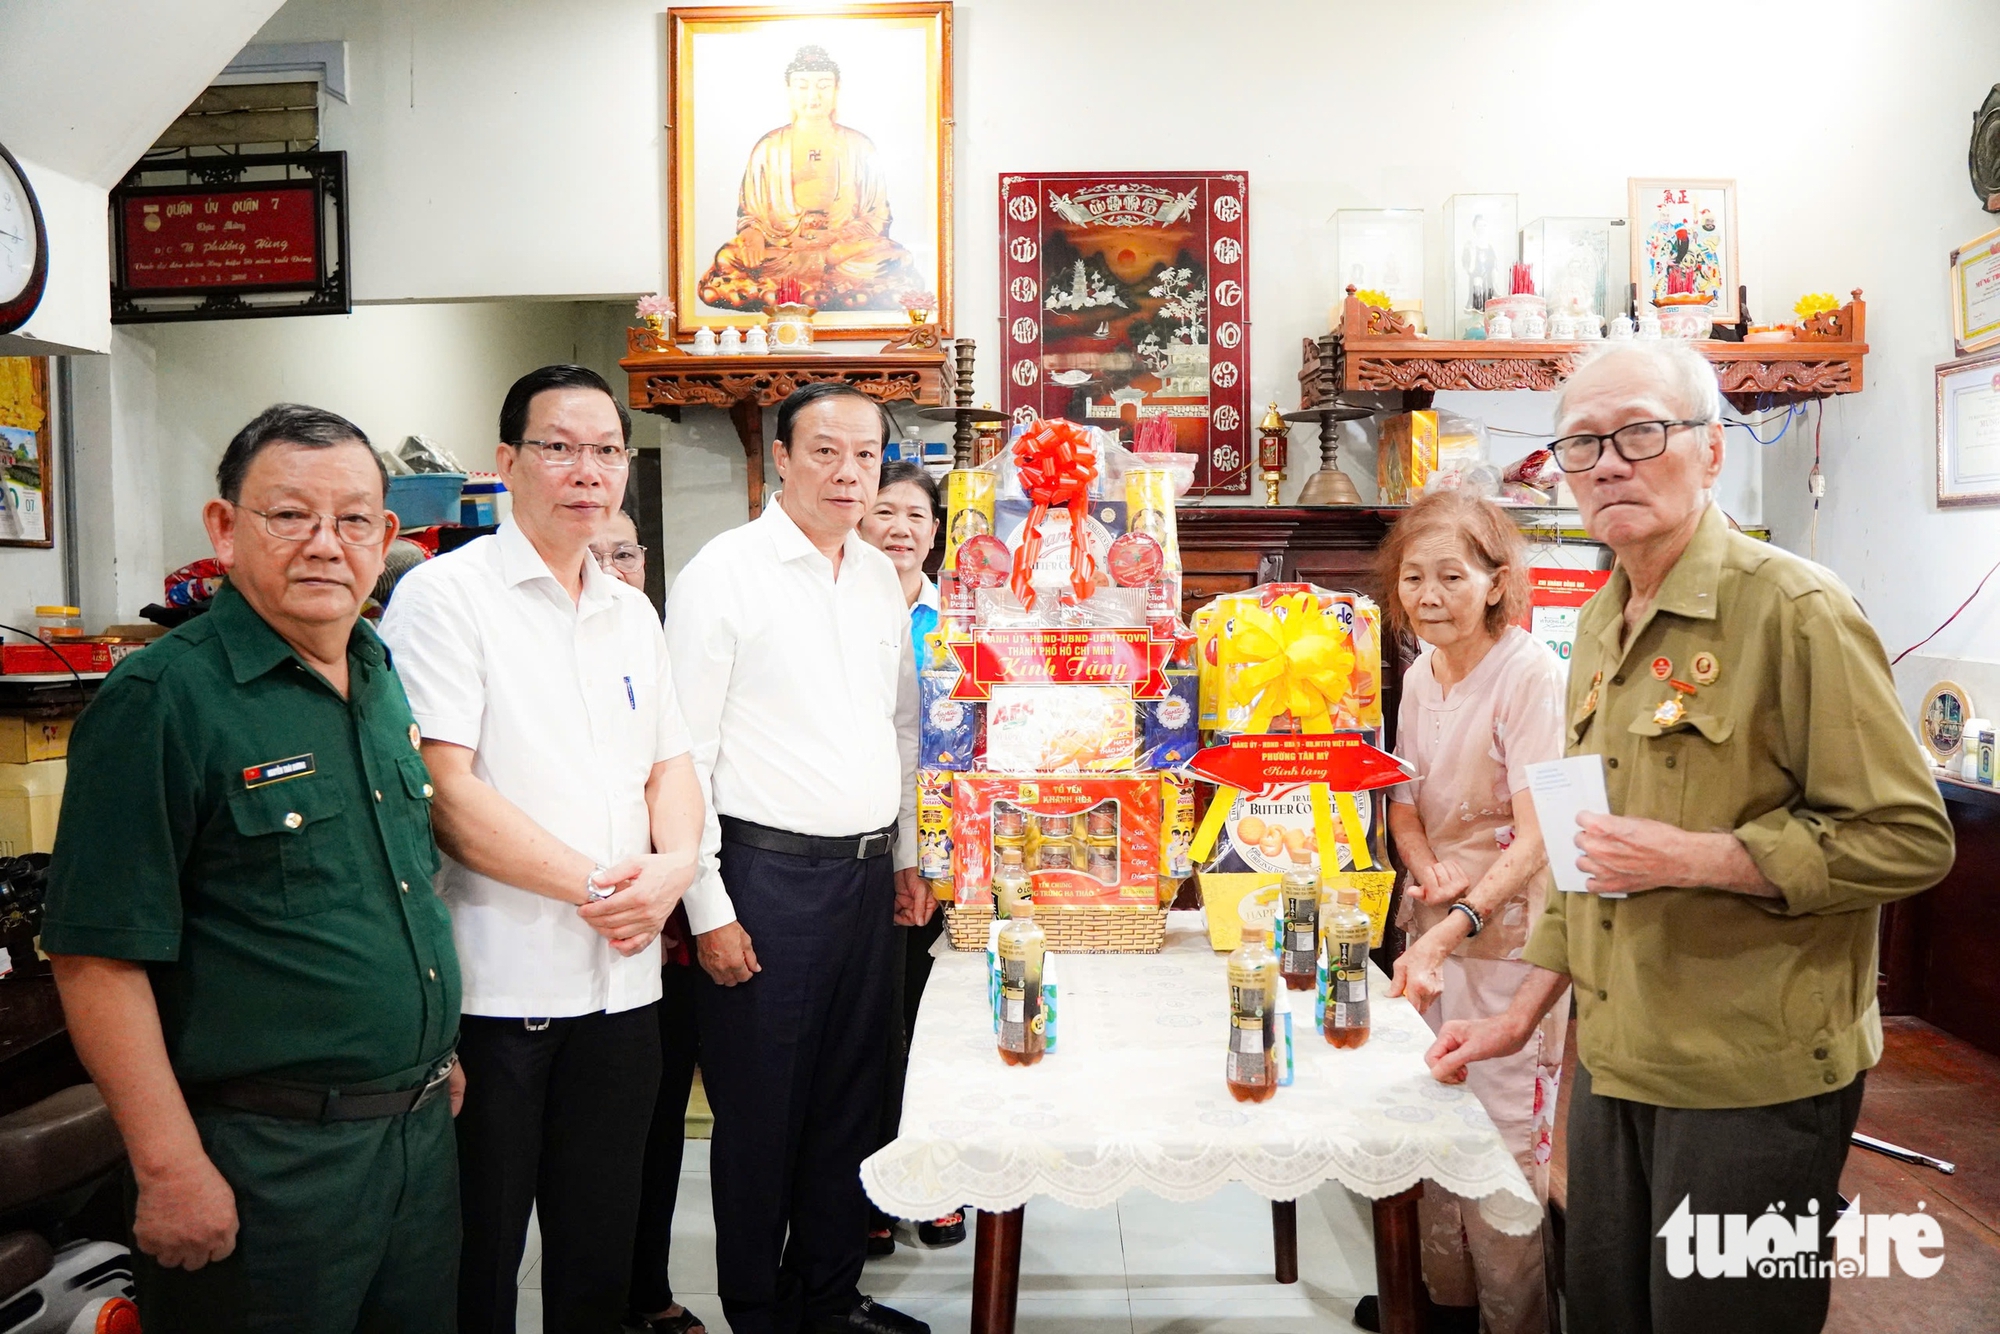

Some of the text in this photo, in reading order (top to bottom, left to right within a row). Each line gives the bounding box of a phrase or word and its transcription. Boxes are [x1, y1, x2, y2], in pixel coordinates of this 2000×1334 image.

[166, 198, 280, 218] QUẬN ỦY QUẬN 7
[254, 237, 289, 251] Hùng
[950, 600, 974, 608] Peach
[976, 632, 1010, 643] THÀNH
[1008, 643, 1116, 656] THÀNH PHỐ HỒ CHÍ MINH
[995, 656, 1128, 680] Kính Tặng
[1261, 750, 1330, 761] PHƯỜNG TÂN MỸ
[1263, 765, 1299, 776] Kính
[1052, 784, 1083, 794] TỔ YẾN
[1042, 795, 1093, 804] KHÁNH HÒA
[1250, 803, 1294, 815] BUTTER
[1131, 858, 1149, 867] Cộng
